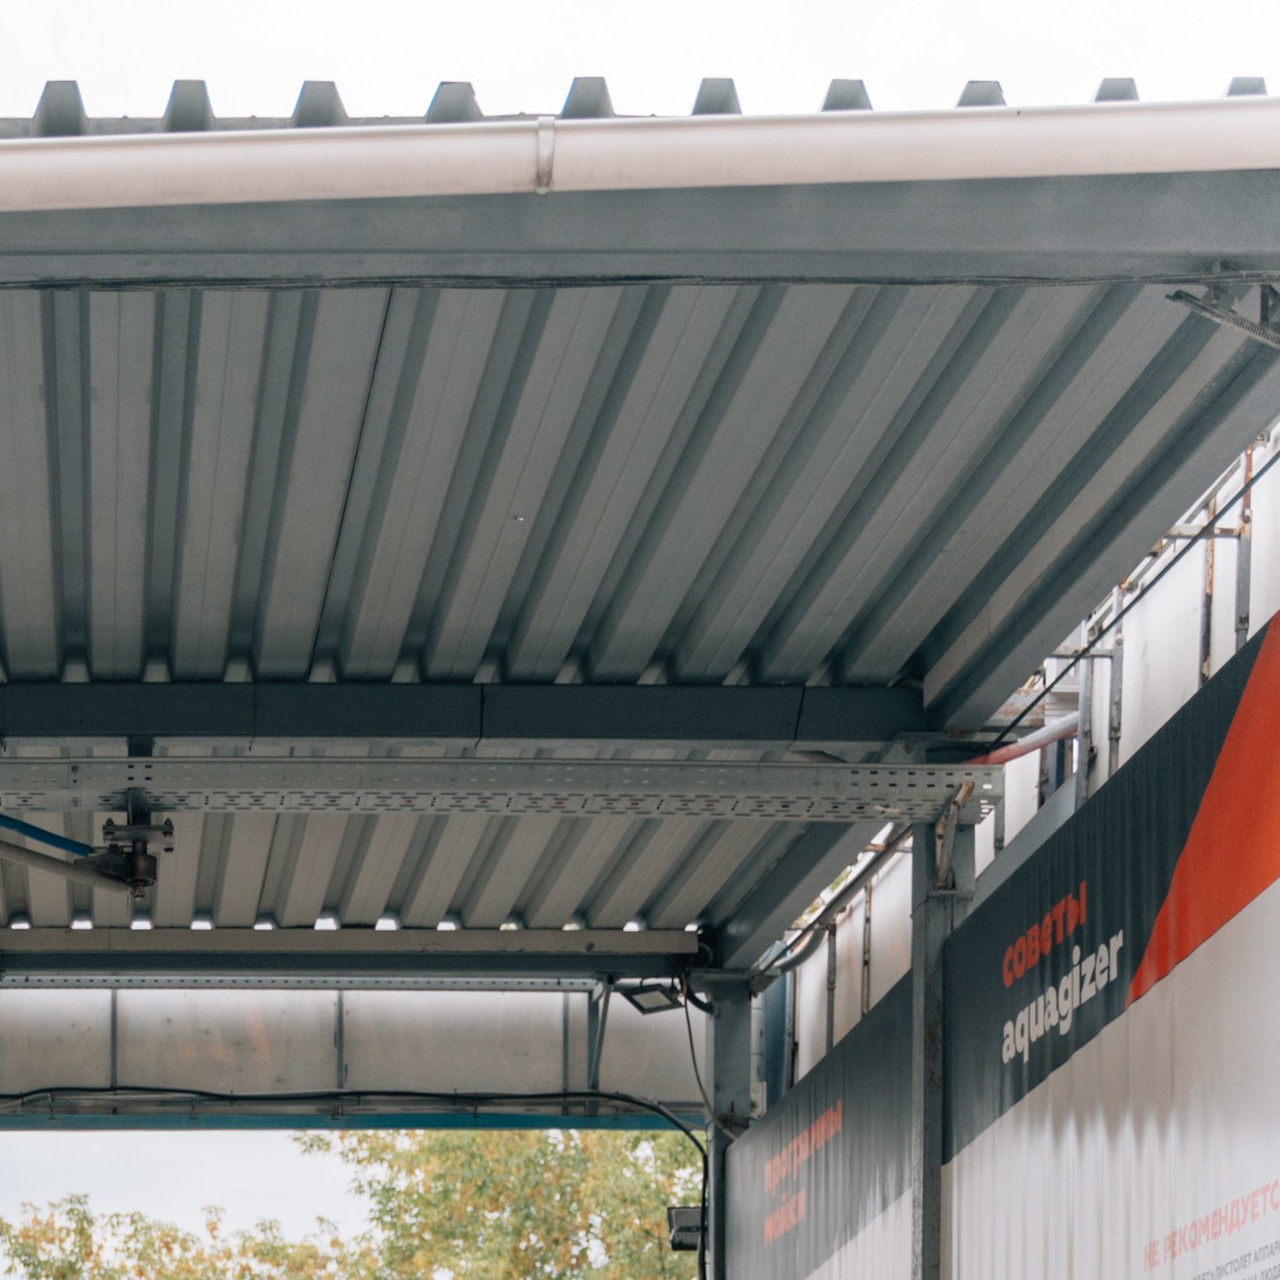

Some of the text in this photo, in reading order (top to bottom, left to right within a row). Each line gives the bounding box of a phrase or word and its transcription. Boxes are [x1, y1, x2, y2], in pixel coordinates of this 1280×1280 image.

[1002, 880, 1087, 988] советы
[1002, 929, 1125, 1064] aquagizer
[1144, 1239, 1160, 1273] НЕ
